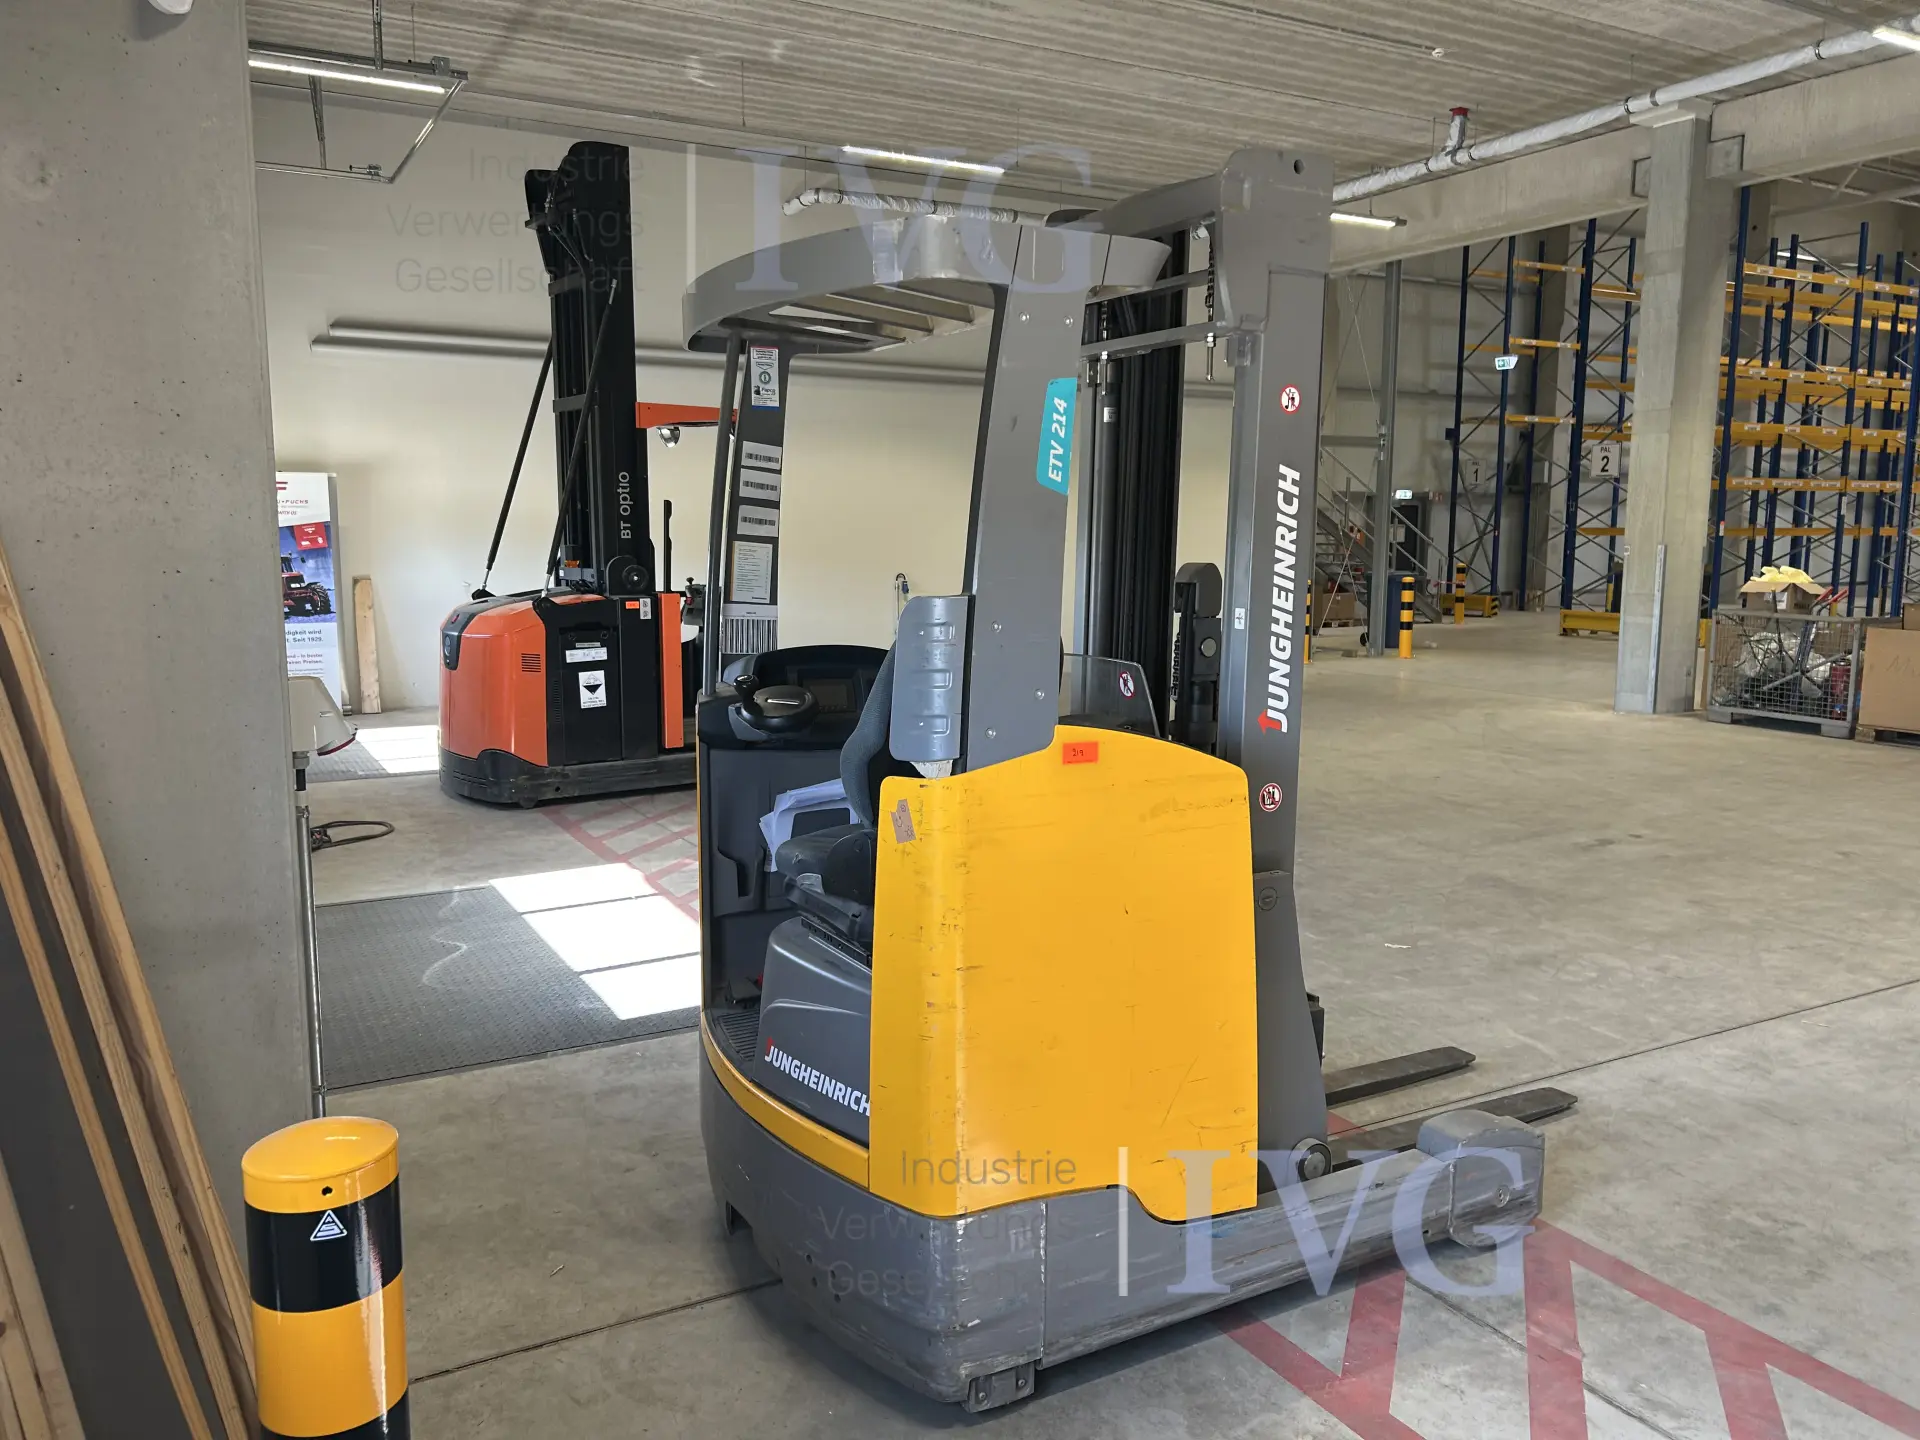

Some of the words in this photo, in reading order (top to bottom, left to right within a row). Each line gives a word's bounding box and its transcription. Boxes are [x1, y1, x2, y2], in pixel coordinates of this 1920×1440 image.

[1051, 397, 1068, 438] 214
[1048, 439, 1064, 483] ETV
[1473, 468, 1479, 482] 1
[1601, 455, 1610, 472] 2
[617, 471, 634, 516] optio
[620, 521, 632, 539] BT
[1263, 463, 1301, 734] JUNGHEINRICH
[764, 1045, 870, 1117] JUNGHEINRICH
